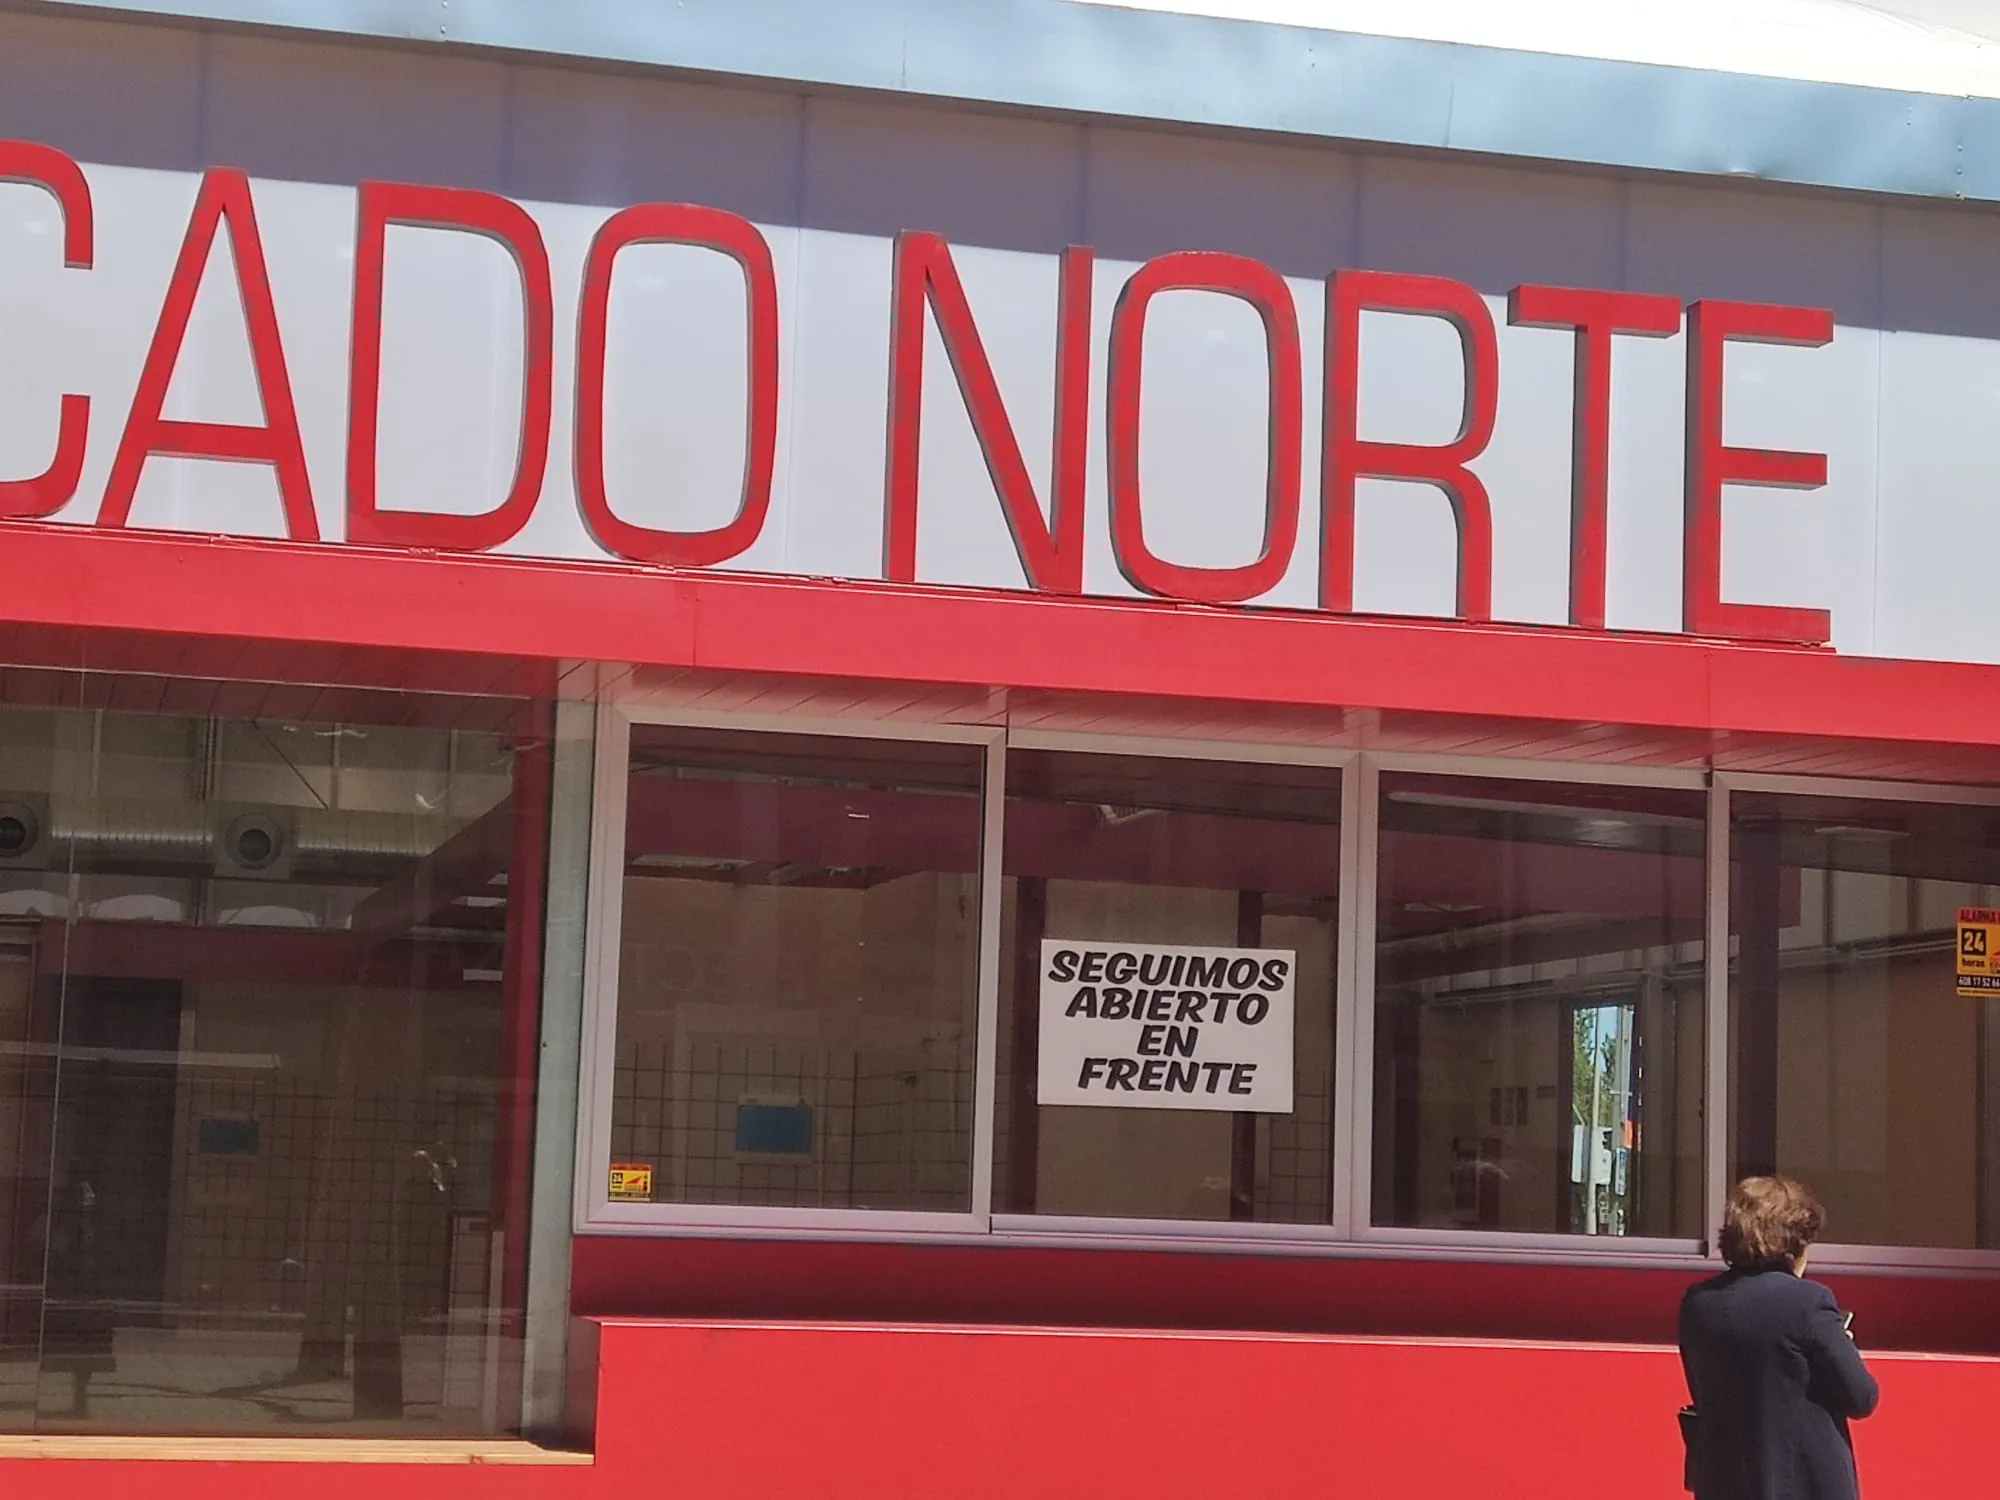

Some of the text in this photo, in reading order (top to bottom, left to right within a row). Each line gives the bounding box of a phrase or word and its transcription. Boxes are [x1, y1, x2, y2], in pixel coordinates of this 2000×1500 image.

[883, 230, 1834, 644] NORTE
[1963, 931, 1985, 952] 24
[1048, 950, 1288, 991] SEGUIMOS
[1065, 986, 1269, 1025] ABIERTO
[1137, 1025, 1198, 1058] EN
[1077, 1057, 1258, 1095] FRENTE
